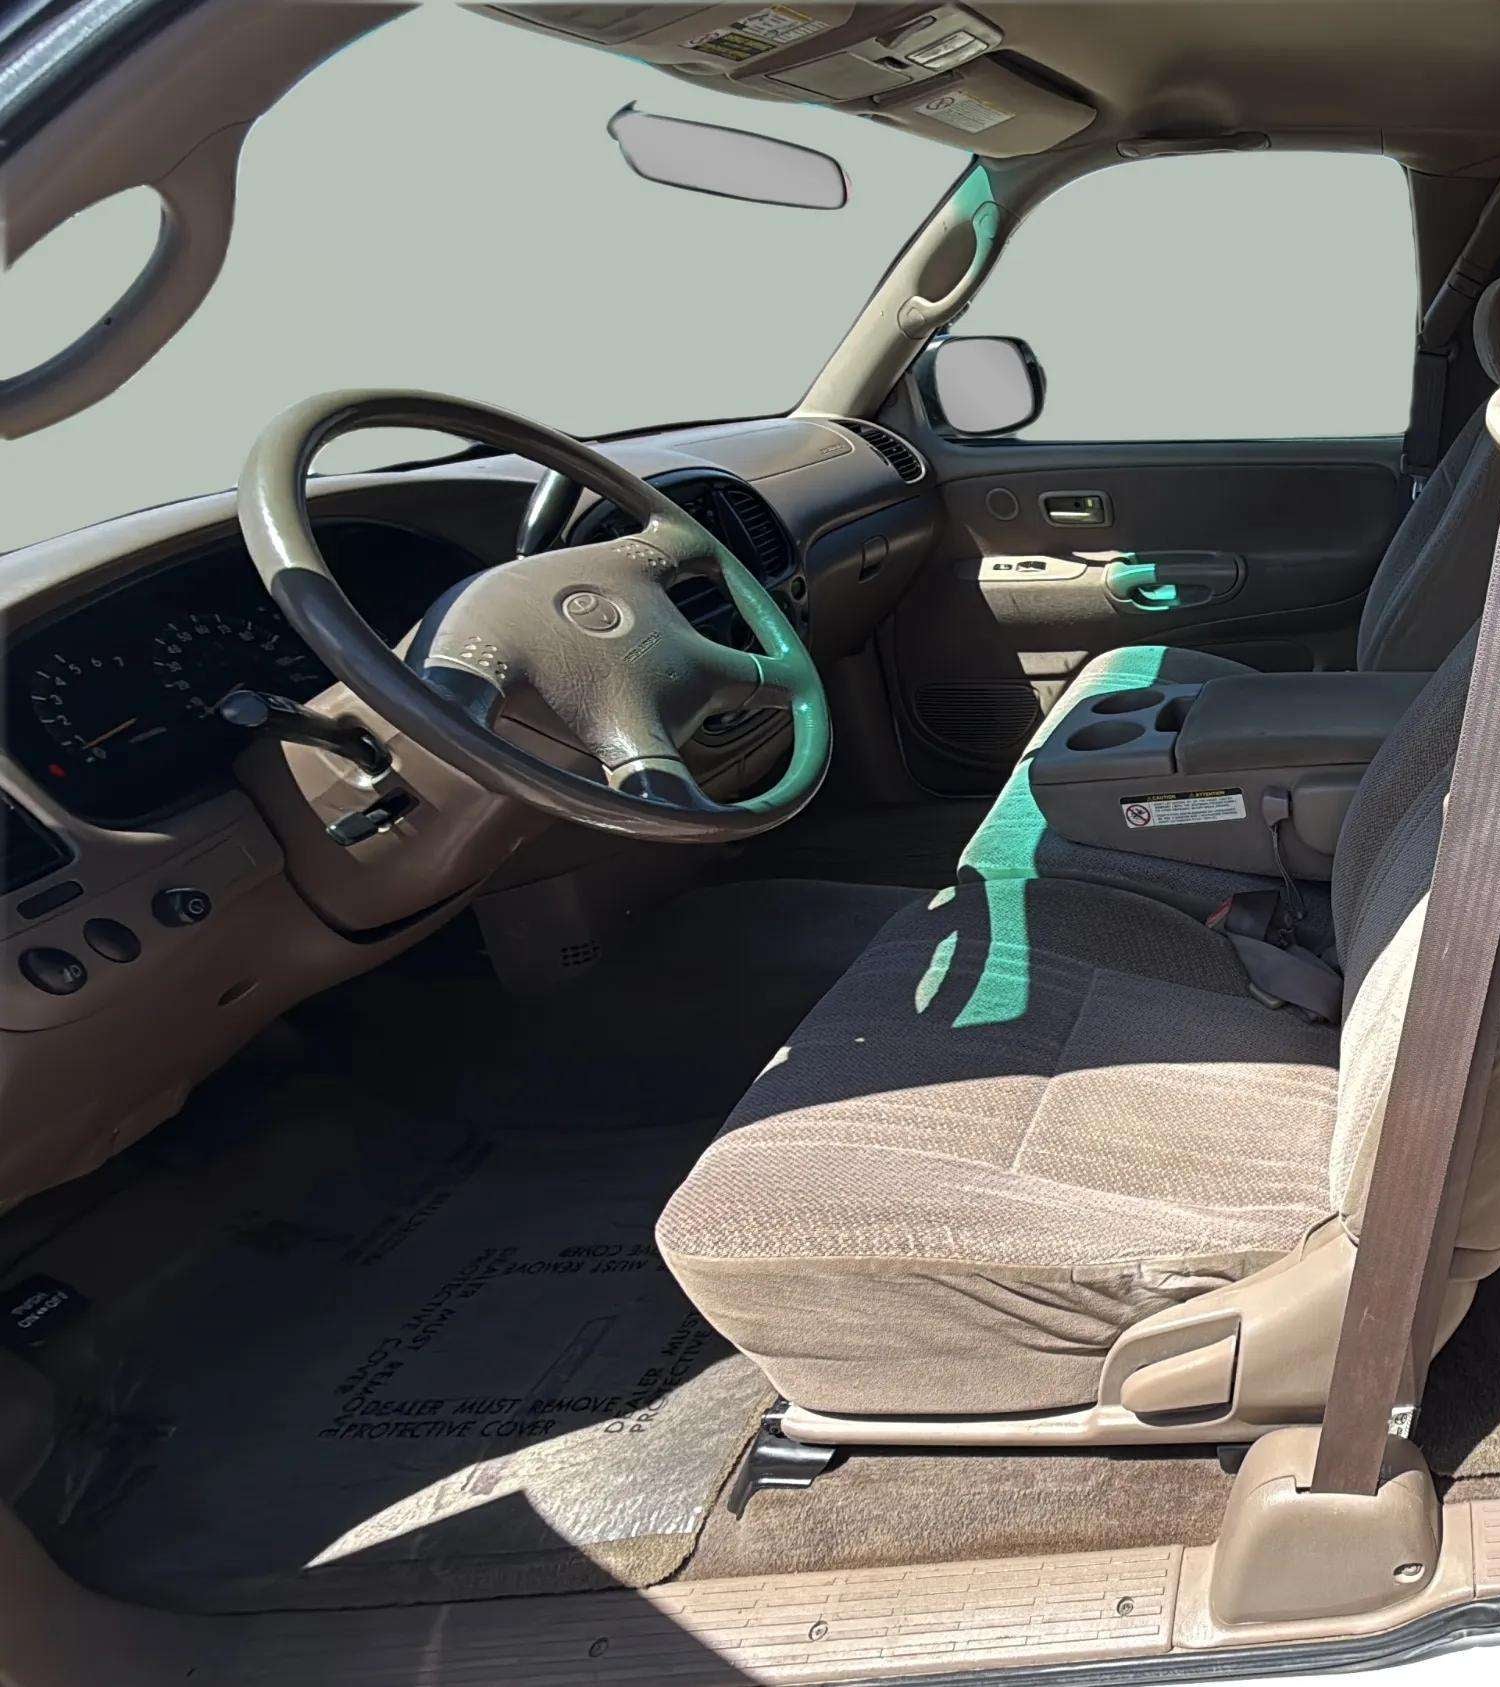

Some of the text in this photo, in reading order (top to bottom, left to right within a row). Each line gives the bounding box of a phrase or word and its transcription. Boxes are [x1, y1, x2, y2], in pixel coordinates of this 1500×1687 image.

[90, 656, 103, 668] 6
[111, 656, 125, 668] 7
[68, 663, 83, 675] 5
[54, 676, 68, 686] 4
[55, 714, 72, 726] 2
[360, 1397, 621, 1417] DEALER MUST REMOVE
[341, 1419, 557, 1440] PROTECTIVE COVER
